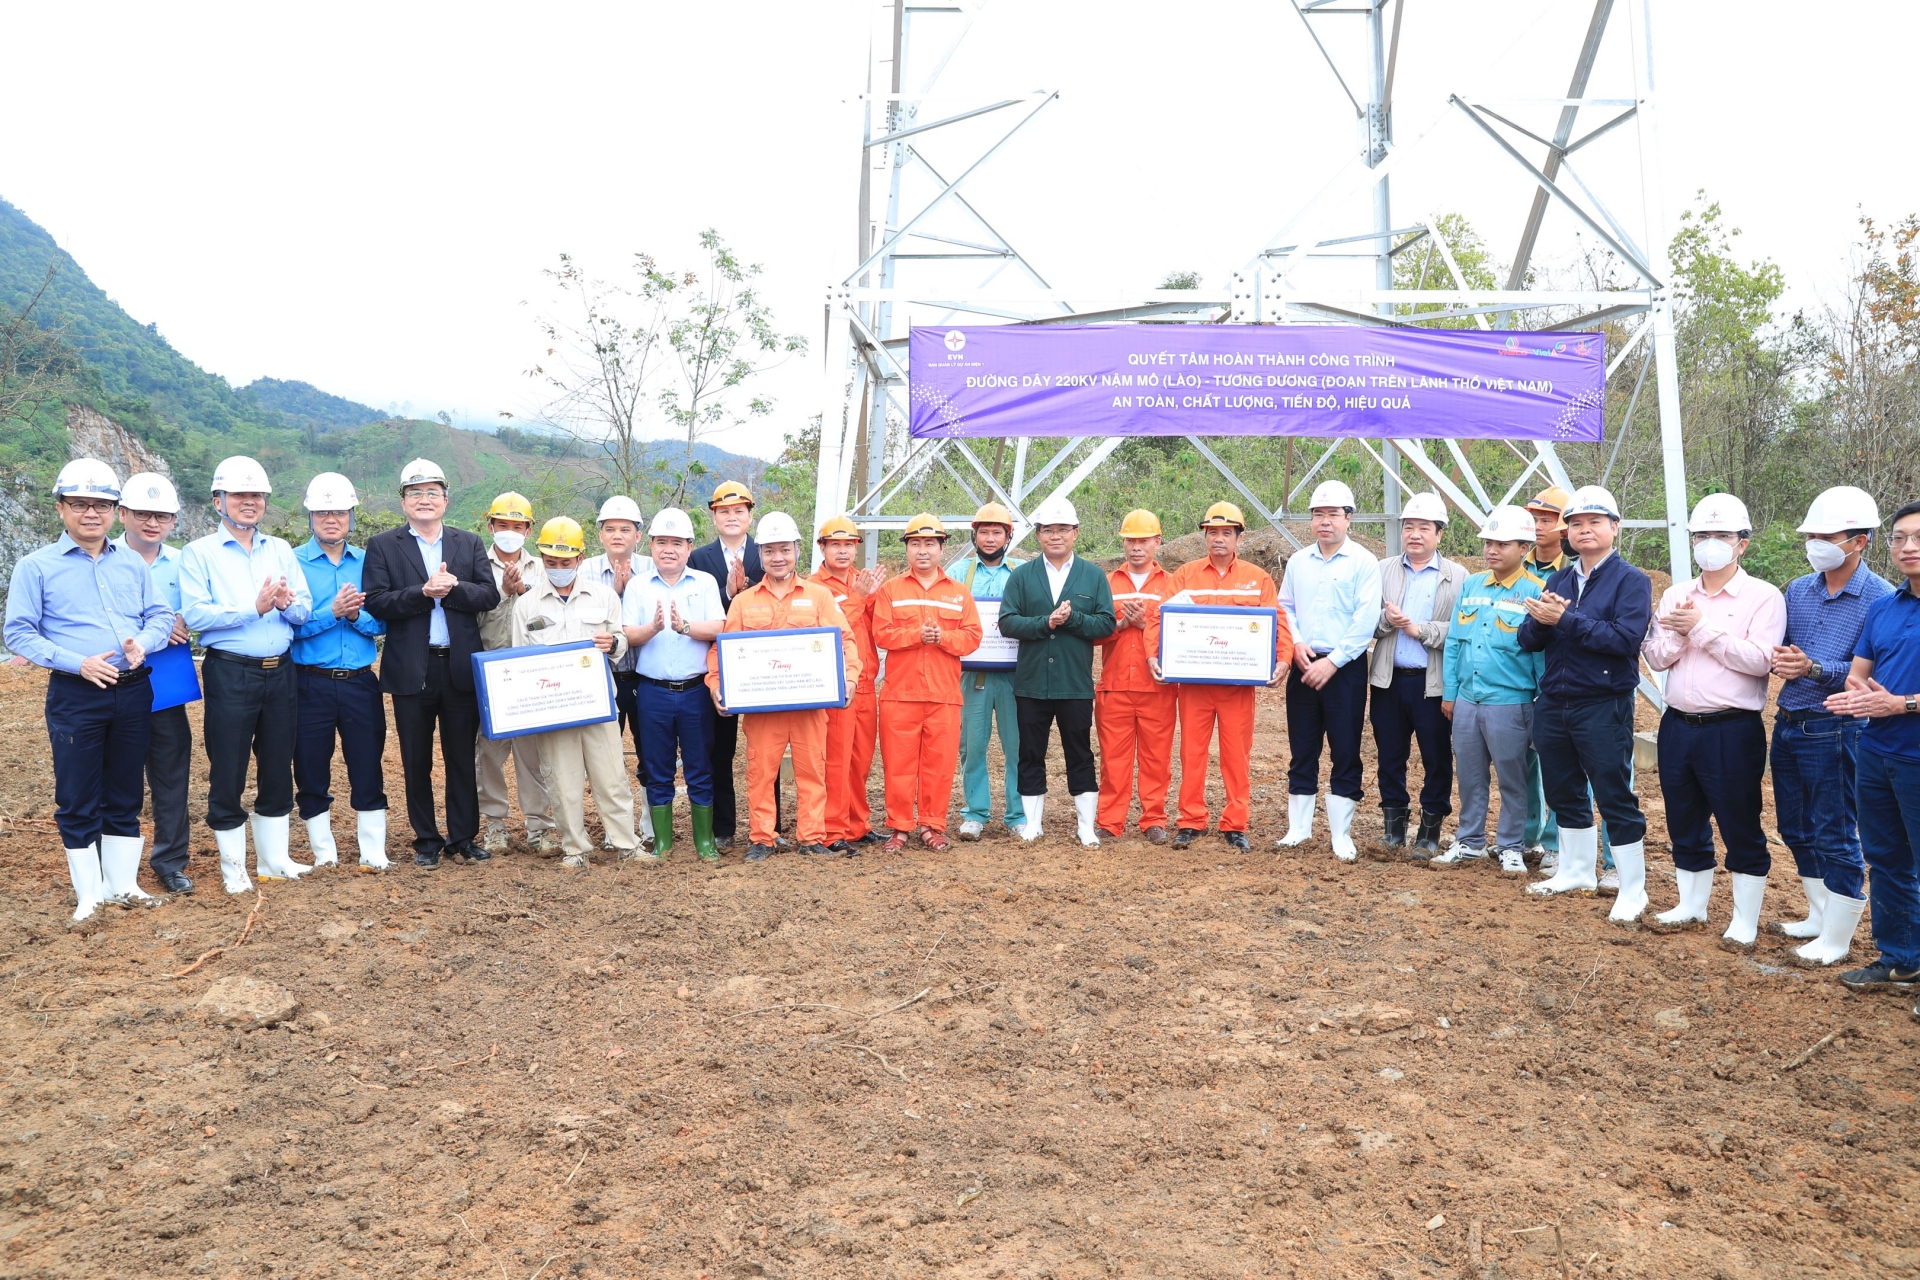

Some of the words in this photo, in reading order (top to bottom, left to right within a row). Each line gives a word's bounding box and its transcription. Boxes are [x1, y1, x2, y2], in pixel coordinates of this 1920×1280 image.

[1128, 350, 1176, 366] QUYẾT
[1179, 352, 1210, 366] TÂM
[1213, 351, 1254, 366] HOÀN
[1257, 352, 1305, 366] THÀNH
[1309, 352, 1350, 367] CÔNG
[1353, 353, 1395, 367] TRÌNH
[966, 374, 1018, 388] ĐƯỜNG
[1022, 373, 1052, 387] DÂY
[1055, 375, 1098, 387] 220KV
[1101, 373, 1133, 388] NẬM
[1137, 373, 1159, 387] MÔ
[1163, 373, 1202, 389] (LÀO)
[1213, 374, 1263, 387] TƯƠNG
[1267, 374, 1318, 388] DƯƠNG
[1321, 375, 1366, 389] (ĐOẠN
[1370, 374, 1407, 388] TRÊN
[1411, 375, 1448, 389] LÃNH
[1452, 375, 1481, 390] THỔ
[1484, 377, 1514, 392] VIỆT
[1517, 380, 1553, 394] NAM)
[1112, 396, 1132, 408] AN
[1135, 394, 1179, 409] TOÀN,
[1182, 392, 1222, 408] CHẤT
[1224, 395, 1278, 411] LƯỢNG,
[1281, 393, 1313, 409] TIẾN
[1316, 395, 1341, 411] ĐỘ,
[1344, 395, 1377, 411] HIỆU
[1380, 394, 1412, 410] QUẢ
